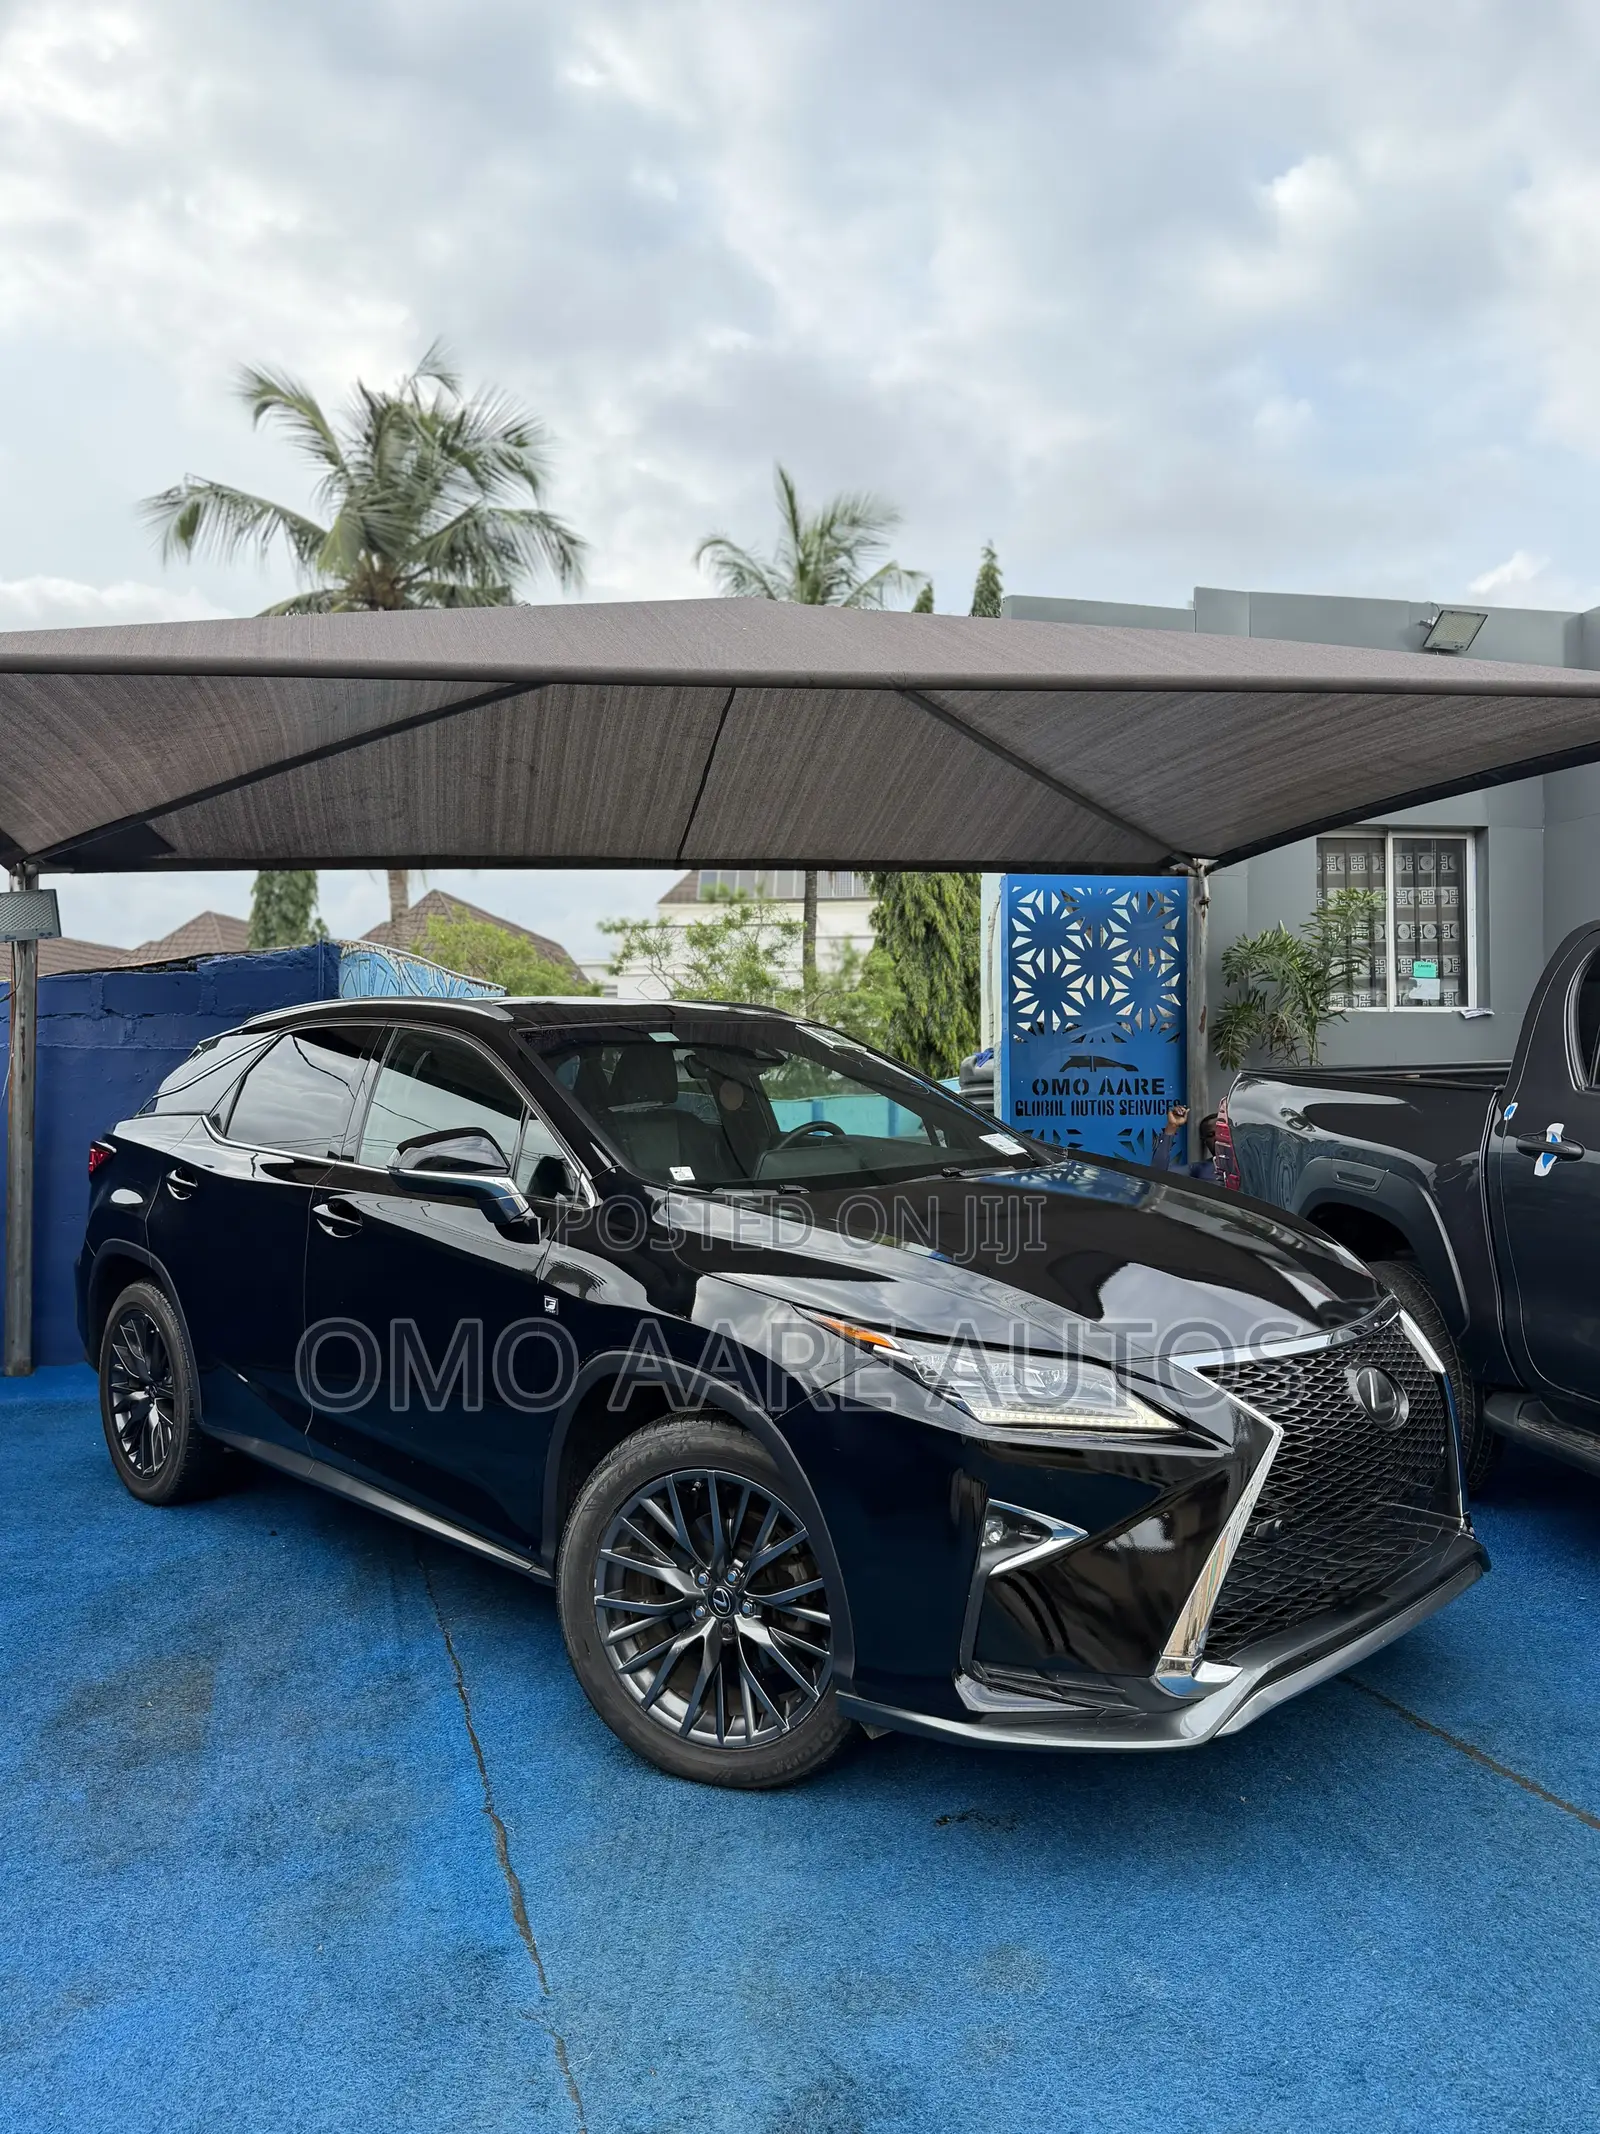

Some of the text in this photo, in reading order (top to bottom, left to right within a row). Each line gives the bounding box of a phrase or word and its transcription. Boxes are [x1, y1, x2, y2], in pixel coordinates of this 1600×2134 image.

[1032, 1078, 1165, 1095] OMO AARE
[1015, 1099, 1066, 1116] GLOBAL
[1071, 1099, 1114, 1116] AUTOS
